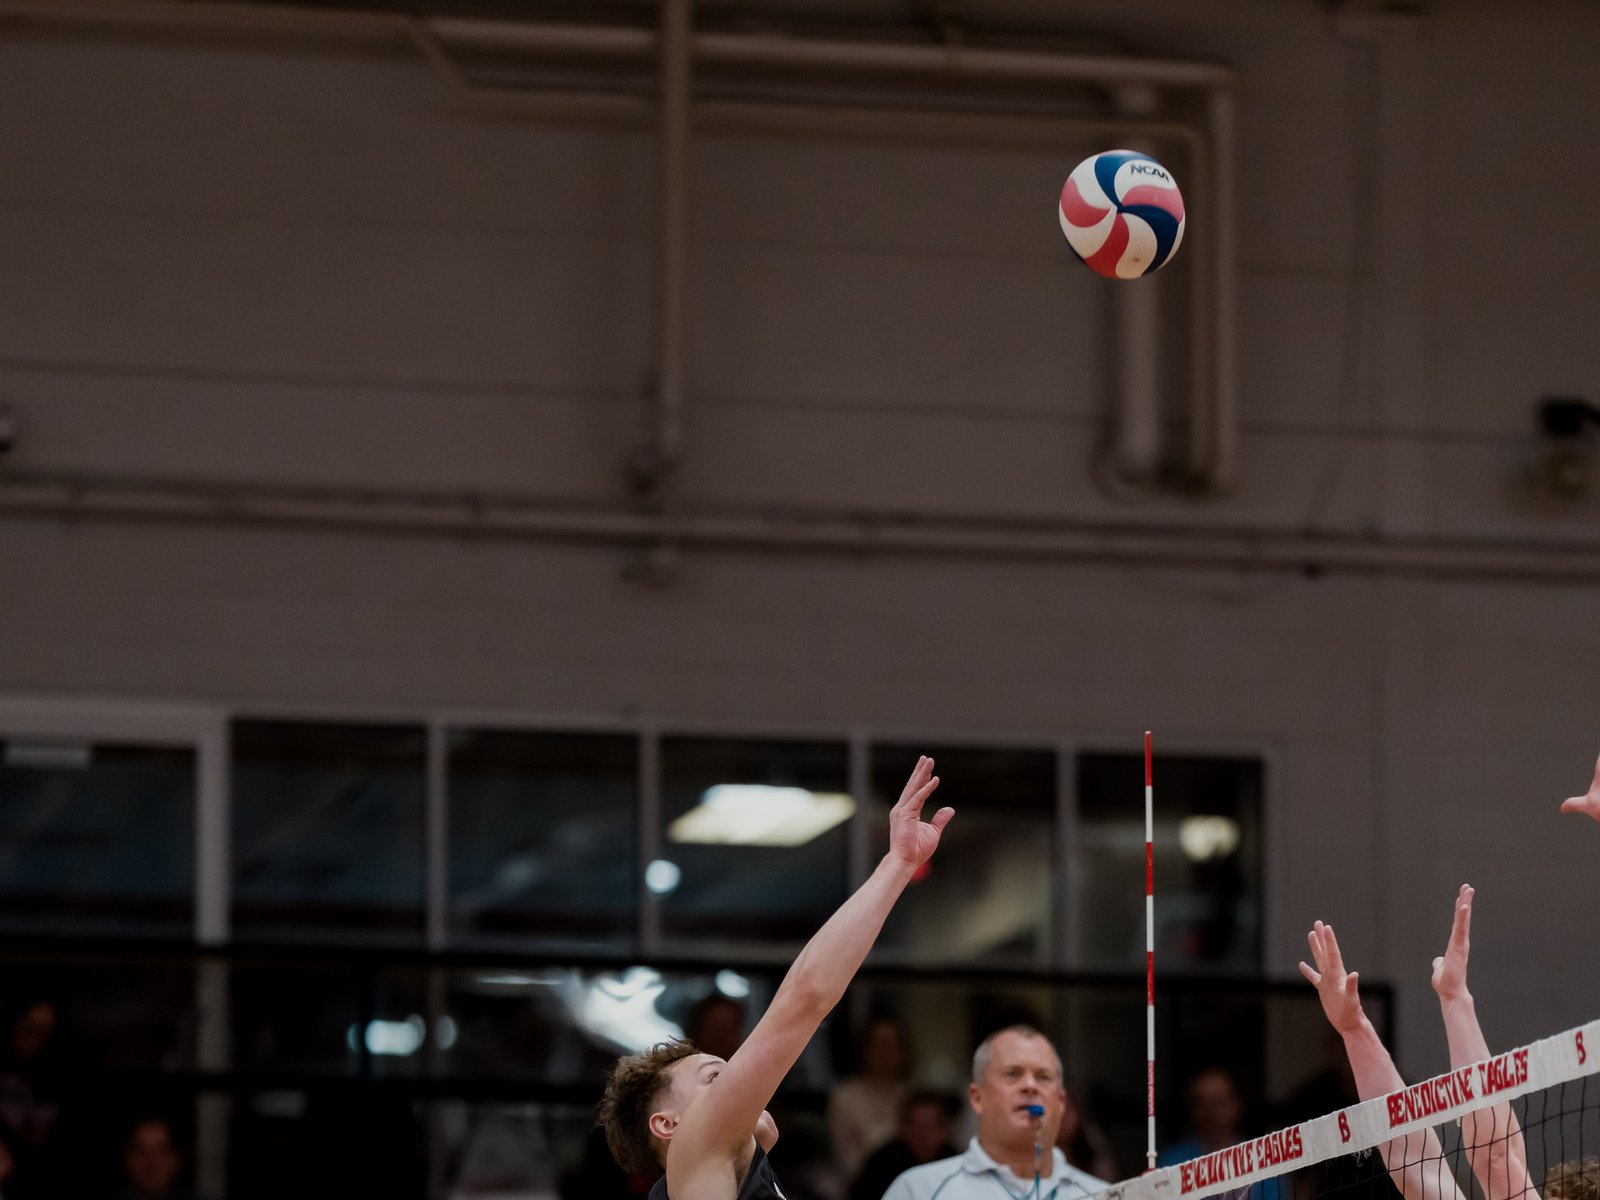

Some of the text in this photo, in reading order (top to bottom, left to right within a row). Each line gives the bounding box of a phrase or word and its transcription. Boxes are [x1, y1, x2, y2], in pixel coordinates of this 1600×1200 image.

[1130, 164, 1170, 183] NCAA
[1575, 1030, 1587, 1066] B
[1386, 1068, 1475, 1129] BENEDICTINE
[1337, 1110, 1351, 1144] B
[1256, 1125, 1303, 1170] EAGLES
